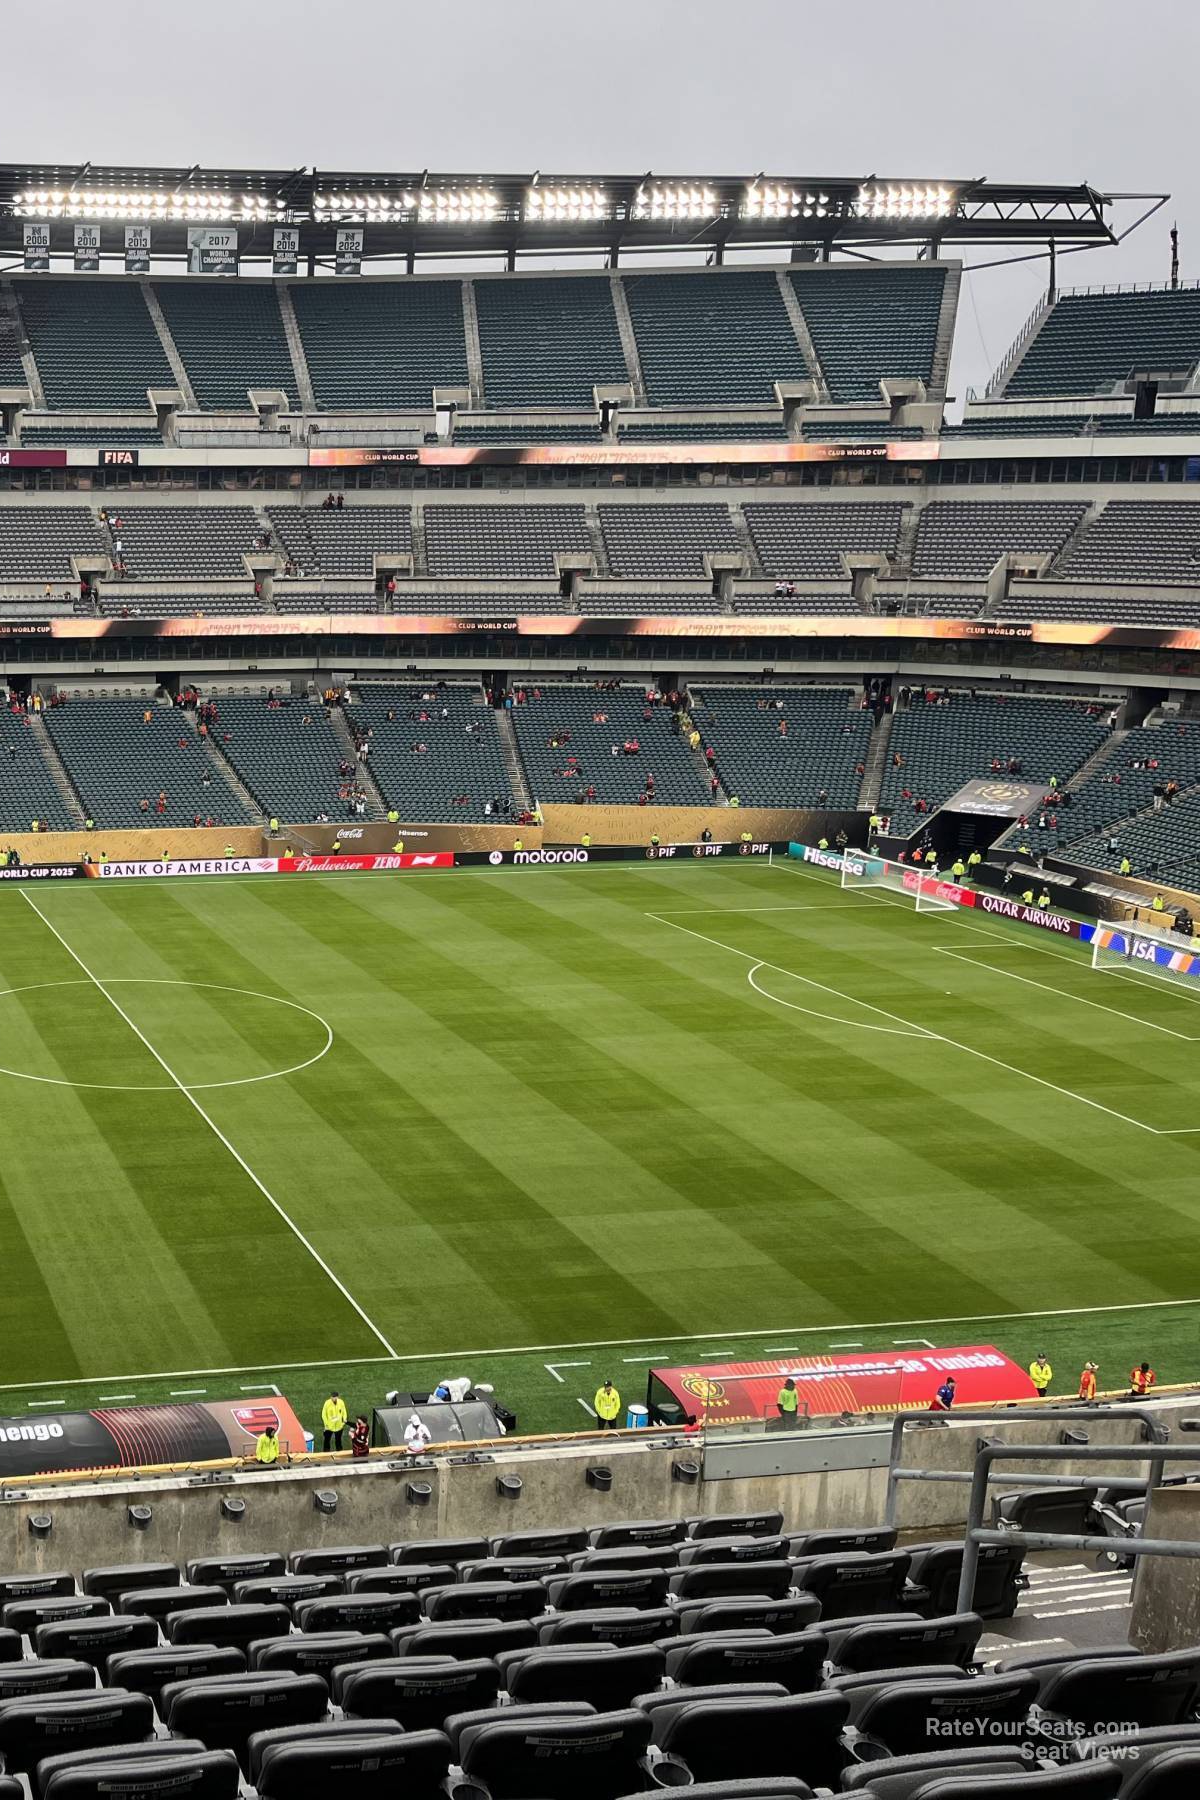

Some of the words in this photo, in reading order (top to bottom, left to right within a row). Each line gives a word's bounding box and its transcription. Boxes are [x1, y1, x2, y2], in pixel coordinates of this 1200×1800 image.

[26, 236, 48, 244] 2006
[78, 237, 96, 246] 2010
[128, 238, 148, 247] 2013
[208, 236, 230, 246] 2017
[276, 241, 296, 250] 2019
[338, 242, 360, 250] 2022
[104, 452, 132, 464] FIFA
[988, 628, 1015, 636] WORLD
[658, 848, 676, 857] PIF
[705, 846, 722, 856] PIF
[752, 844, 769, 854] PIF
[514, 848, 588, 864] motorola
[804, 846, 864, 876] Hisense
[103, 864, 148, 876] BANK
[152, 864, 173, 874] OF
[177, 861, 251, 874] AMERICA
[294, 858, 363, 872] Budweiser
[372, 856, 401, 869] ZERO
[30, 869, 50, 877] CUP
[982, 896, 1018, 918] QATAR
[1022, 909, 1071, 933] AIRWAYS
